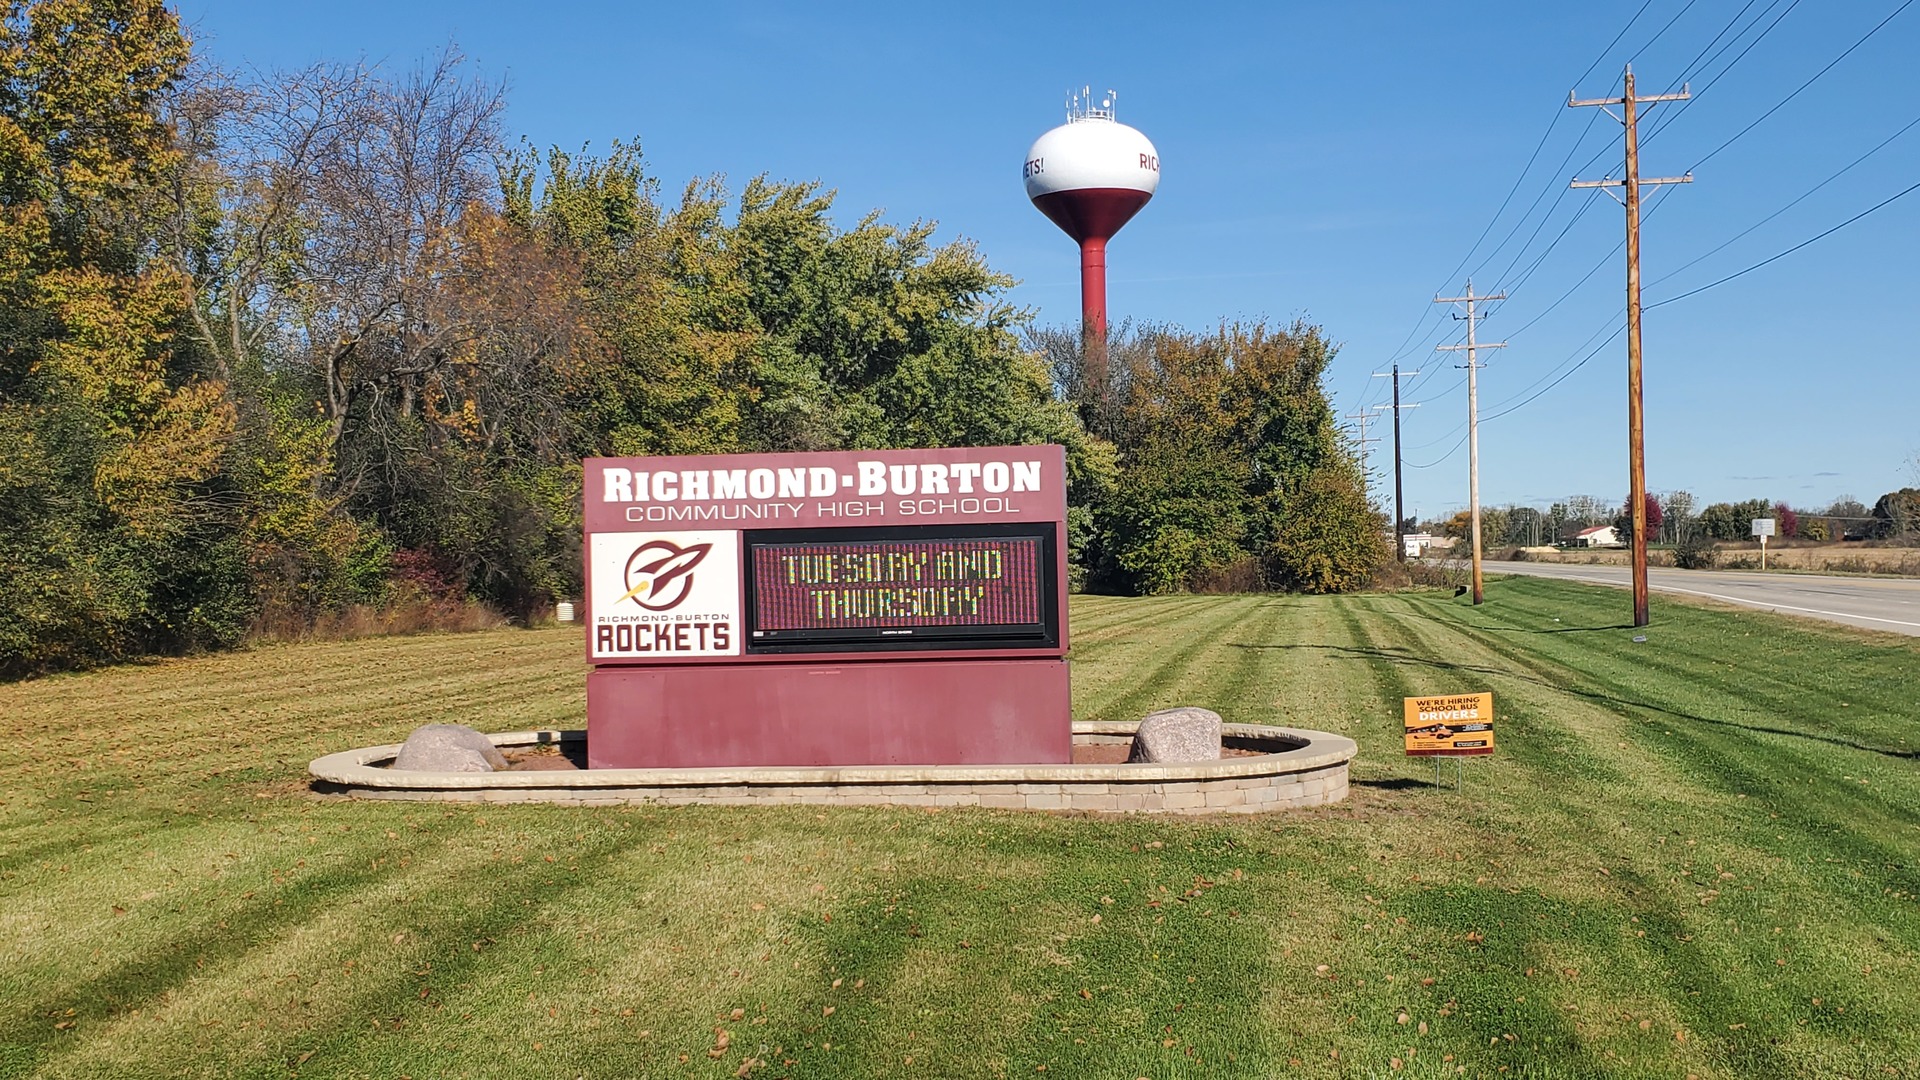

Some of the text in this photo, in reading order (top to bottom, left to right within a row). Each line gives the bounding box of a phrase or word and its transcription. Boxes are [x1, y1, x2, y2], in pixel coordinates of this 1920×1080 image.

[1023, 157, 1044, 178] ETS!
[625, 497, 1020, 522] COMMUNITY HIGH SCHOOL
[782, 549, 1003, 584] TUESDAY AND
[598, 613, 730, 623] RICHMOND-BURTON
[597, 622, 730, 652] ROCKETS
[1447, 697, 1480, 705] HIRING
[1419, 710, 1479, 721] DRIVERS
